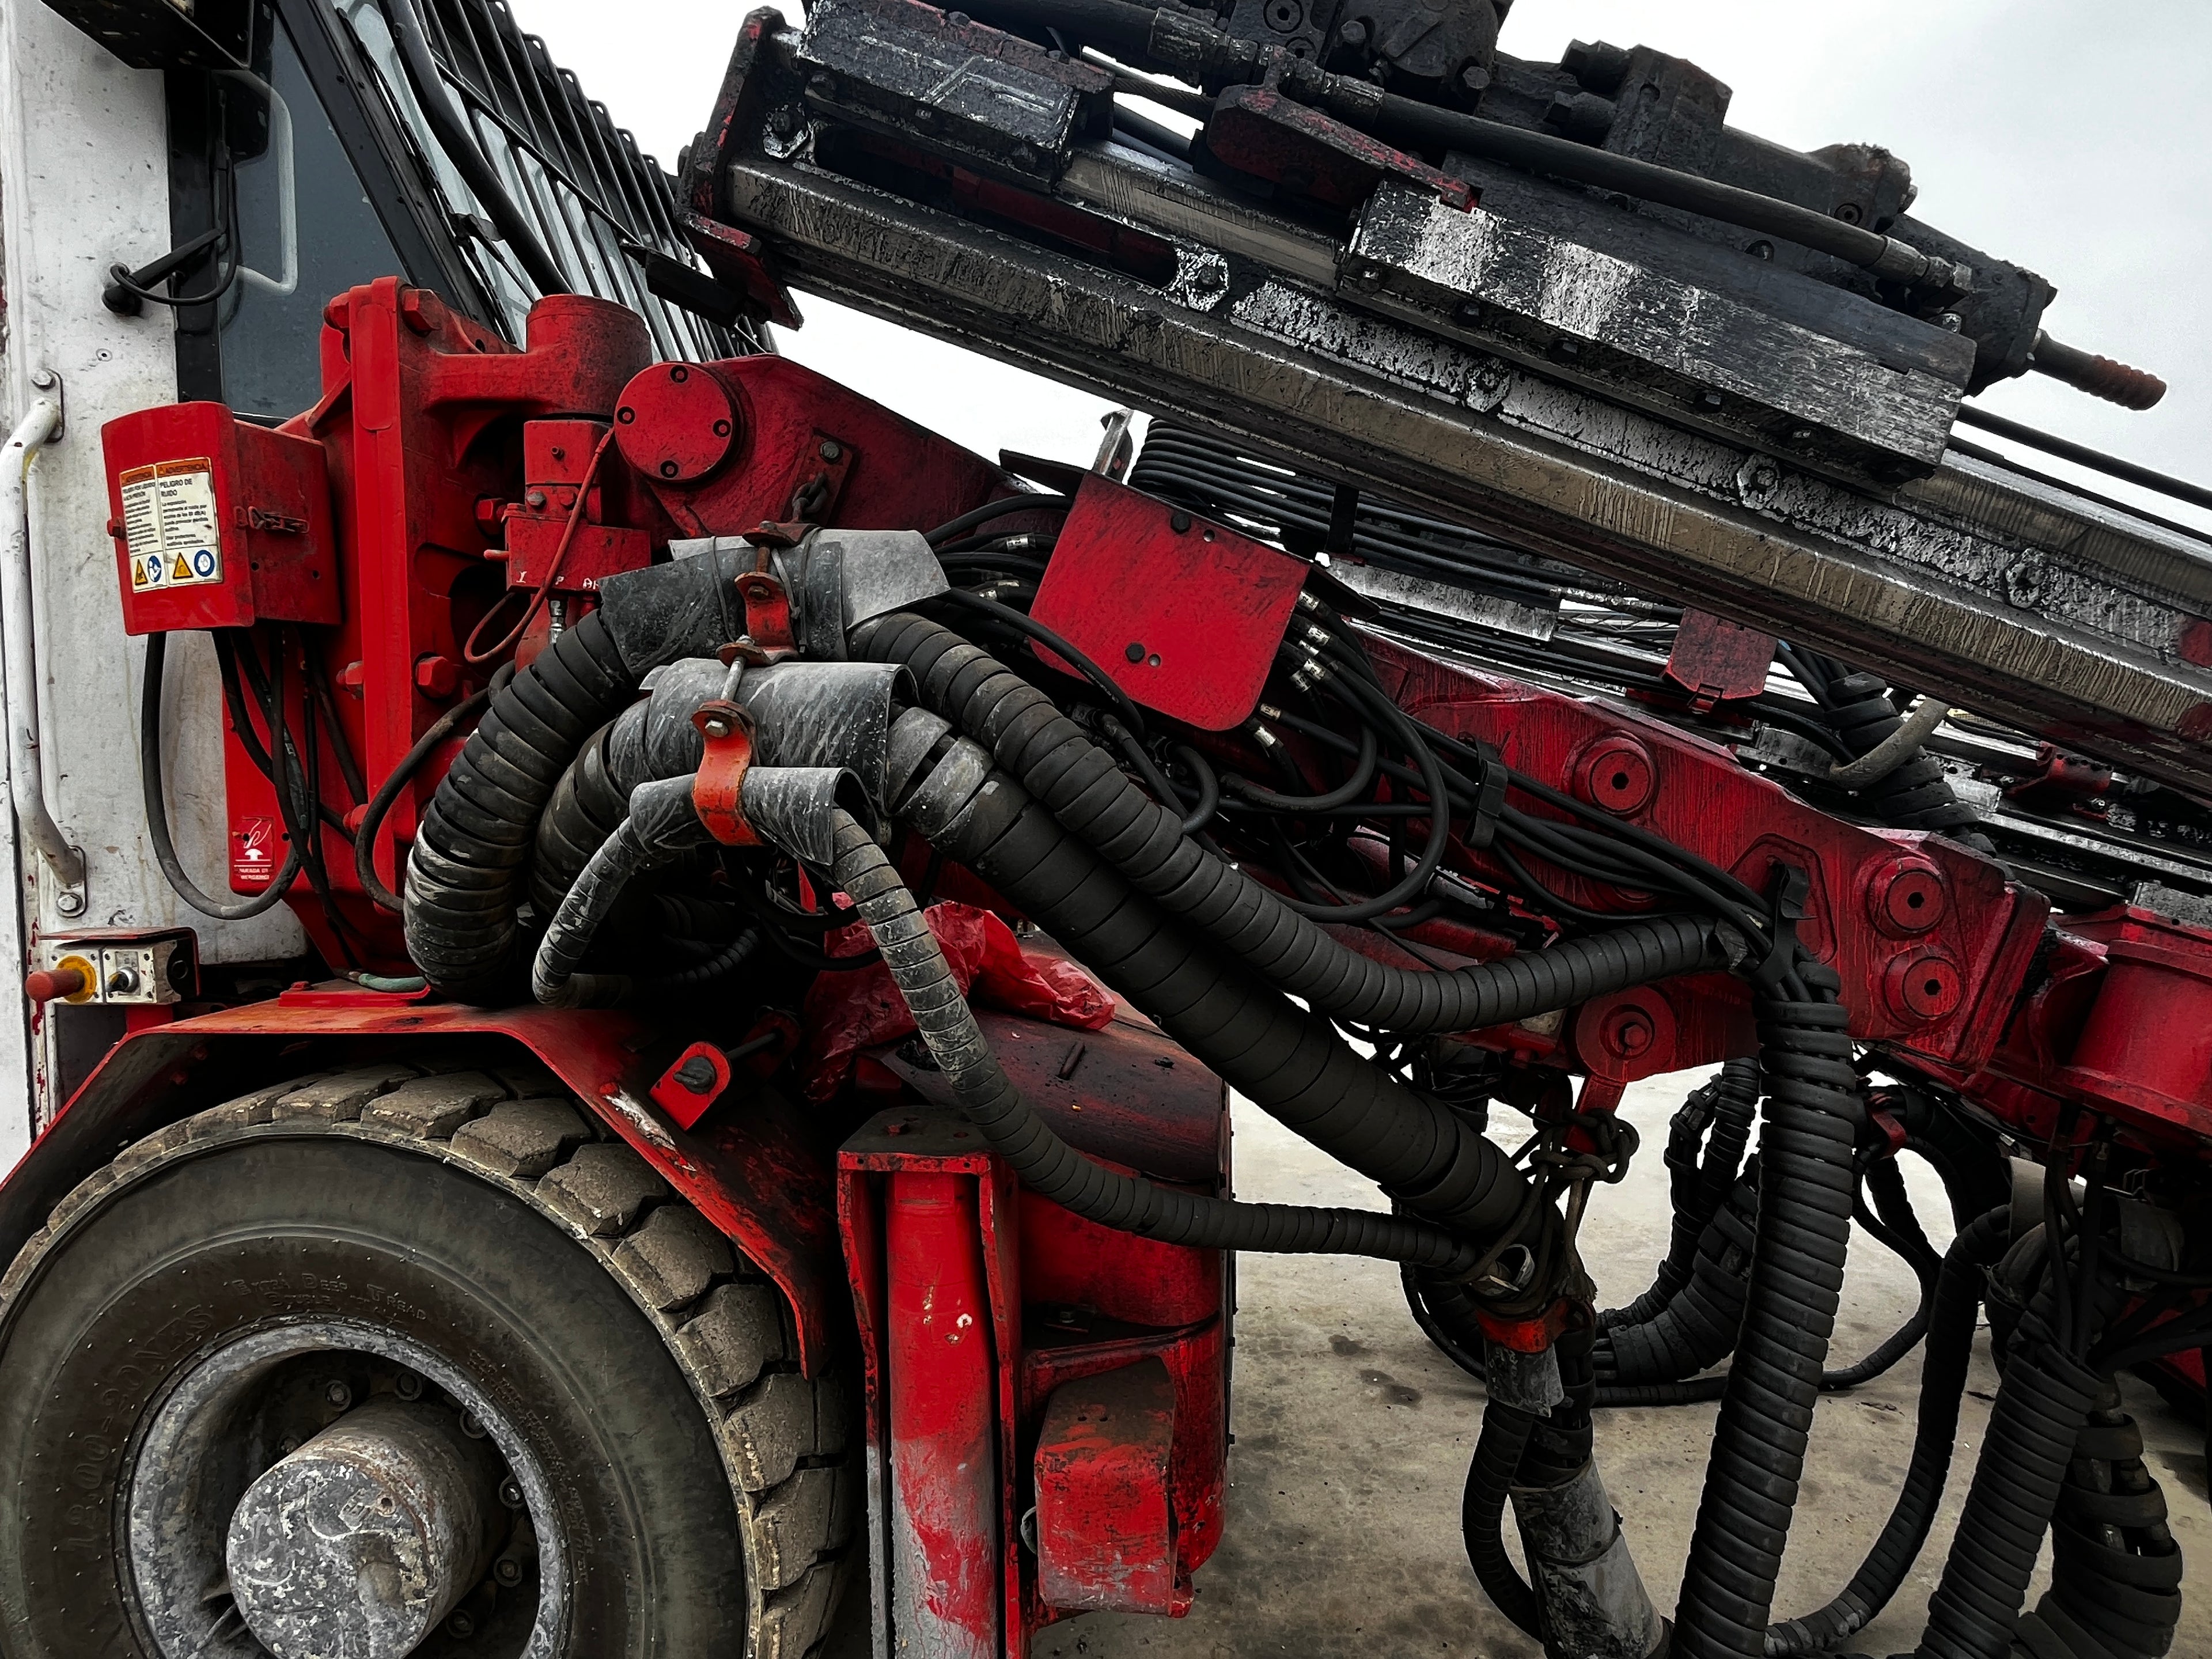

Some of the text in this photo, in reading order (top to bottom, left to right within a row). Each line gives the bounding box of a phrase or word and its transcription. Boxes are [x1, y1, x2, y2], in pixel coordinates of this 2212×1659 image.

[160, 479, 183, 488] PELIGRO
[301, 1272, 348, 1293] DEEP
[366, 1283, 427, 1320] TREAD
